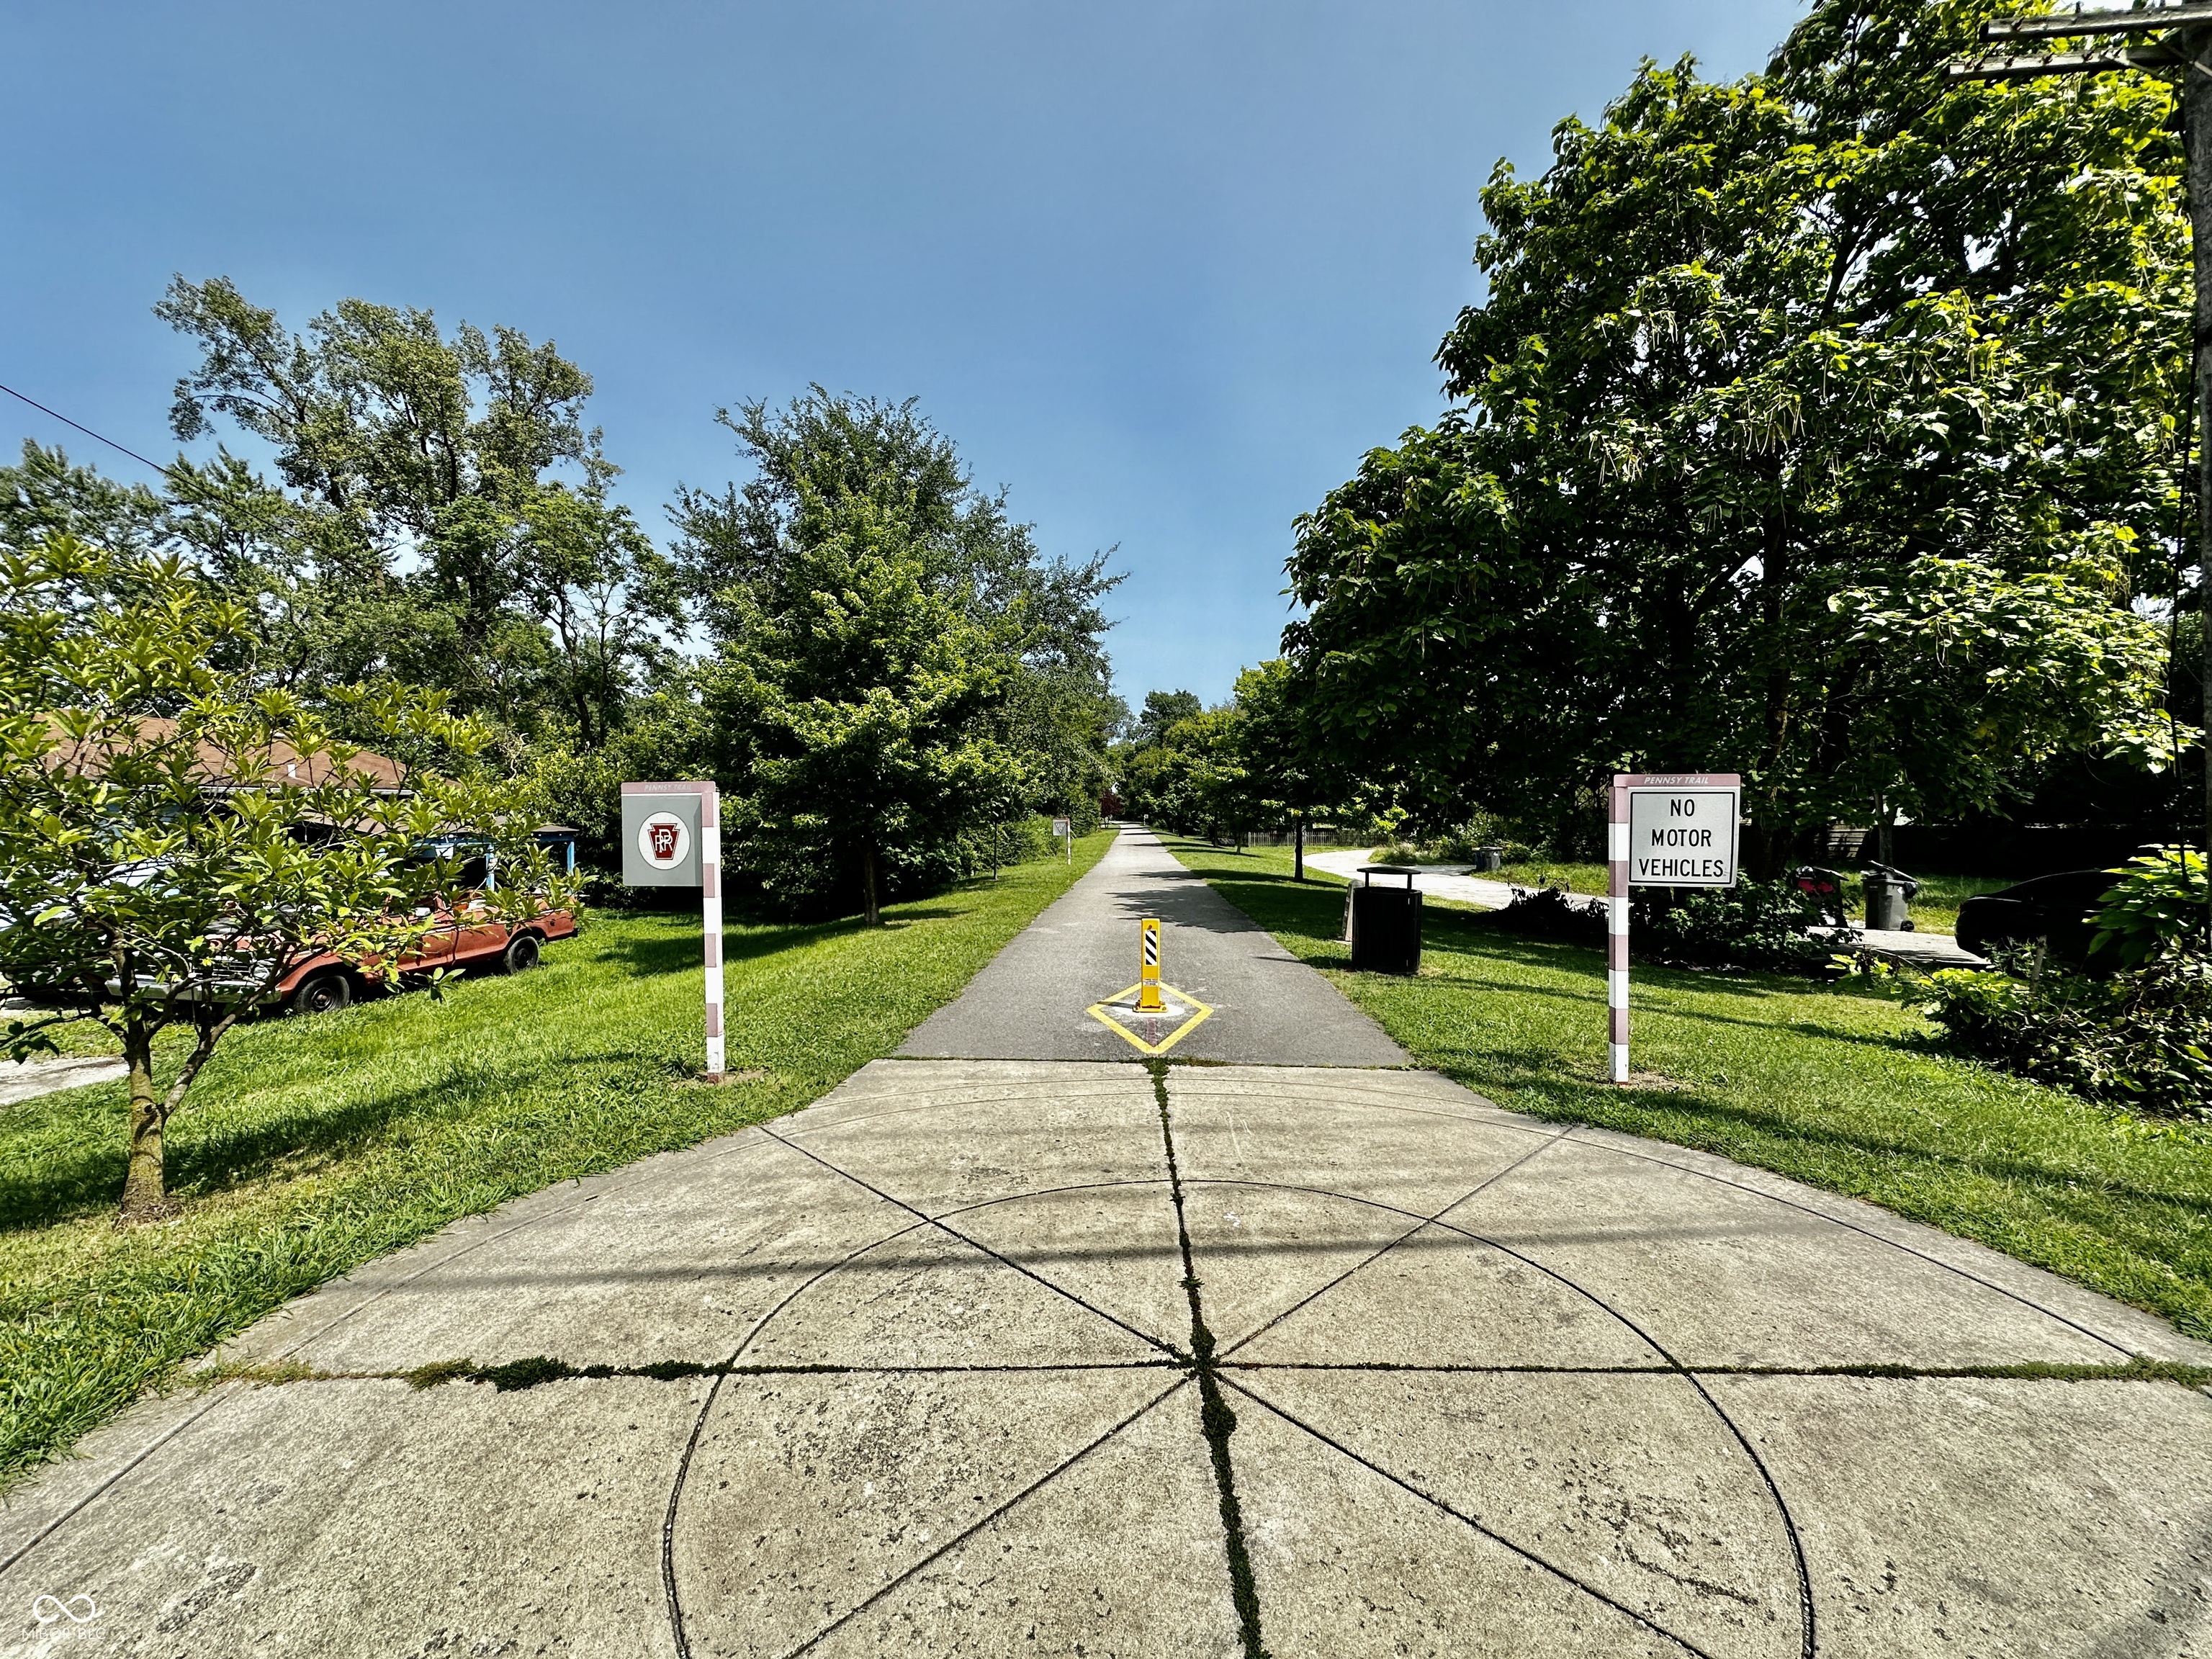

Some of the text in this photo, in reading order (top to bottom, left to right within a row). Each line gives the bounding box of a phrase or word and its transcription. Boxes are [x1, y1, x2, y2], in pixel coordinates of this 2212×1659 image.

[1670, 799, 1695, 817] NO
[1651, 829, 1712, 847] MOTOR
[1638, 858, 1724, 877] VEHICLES
